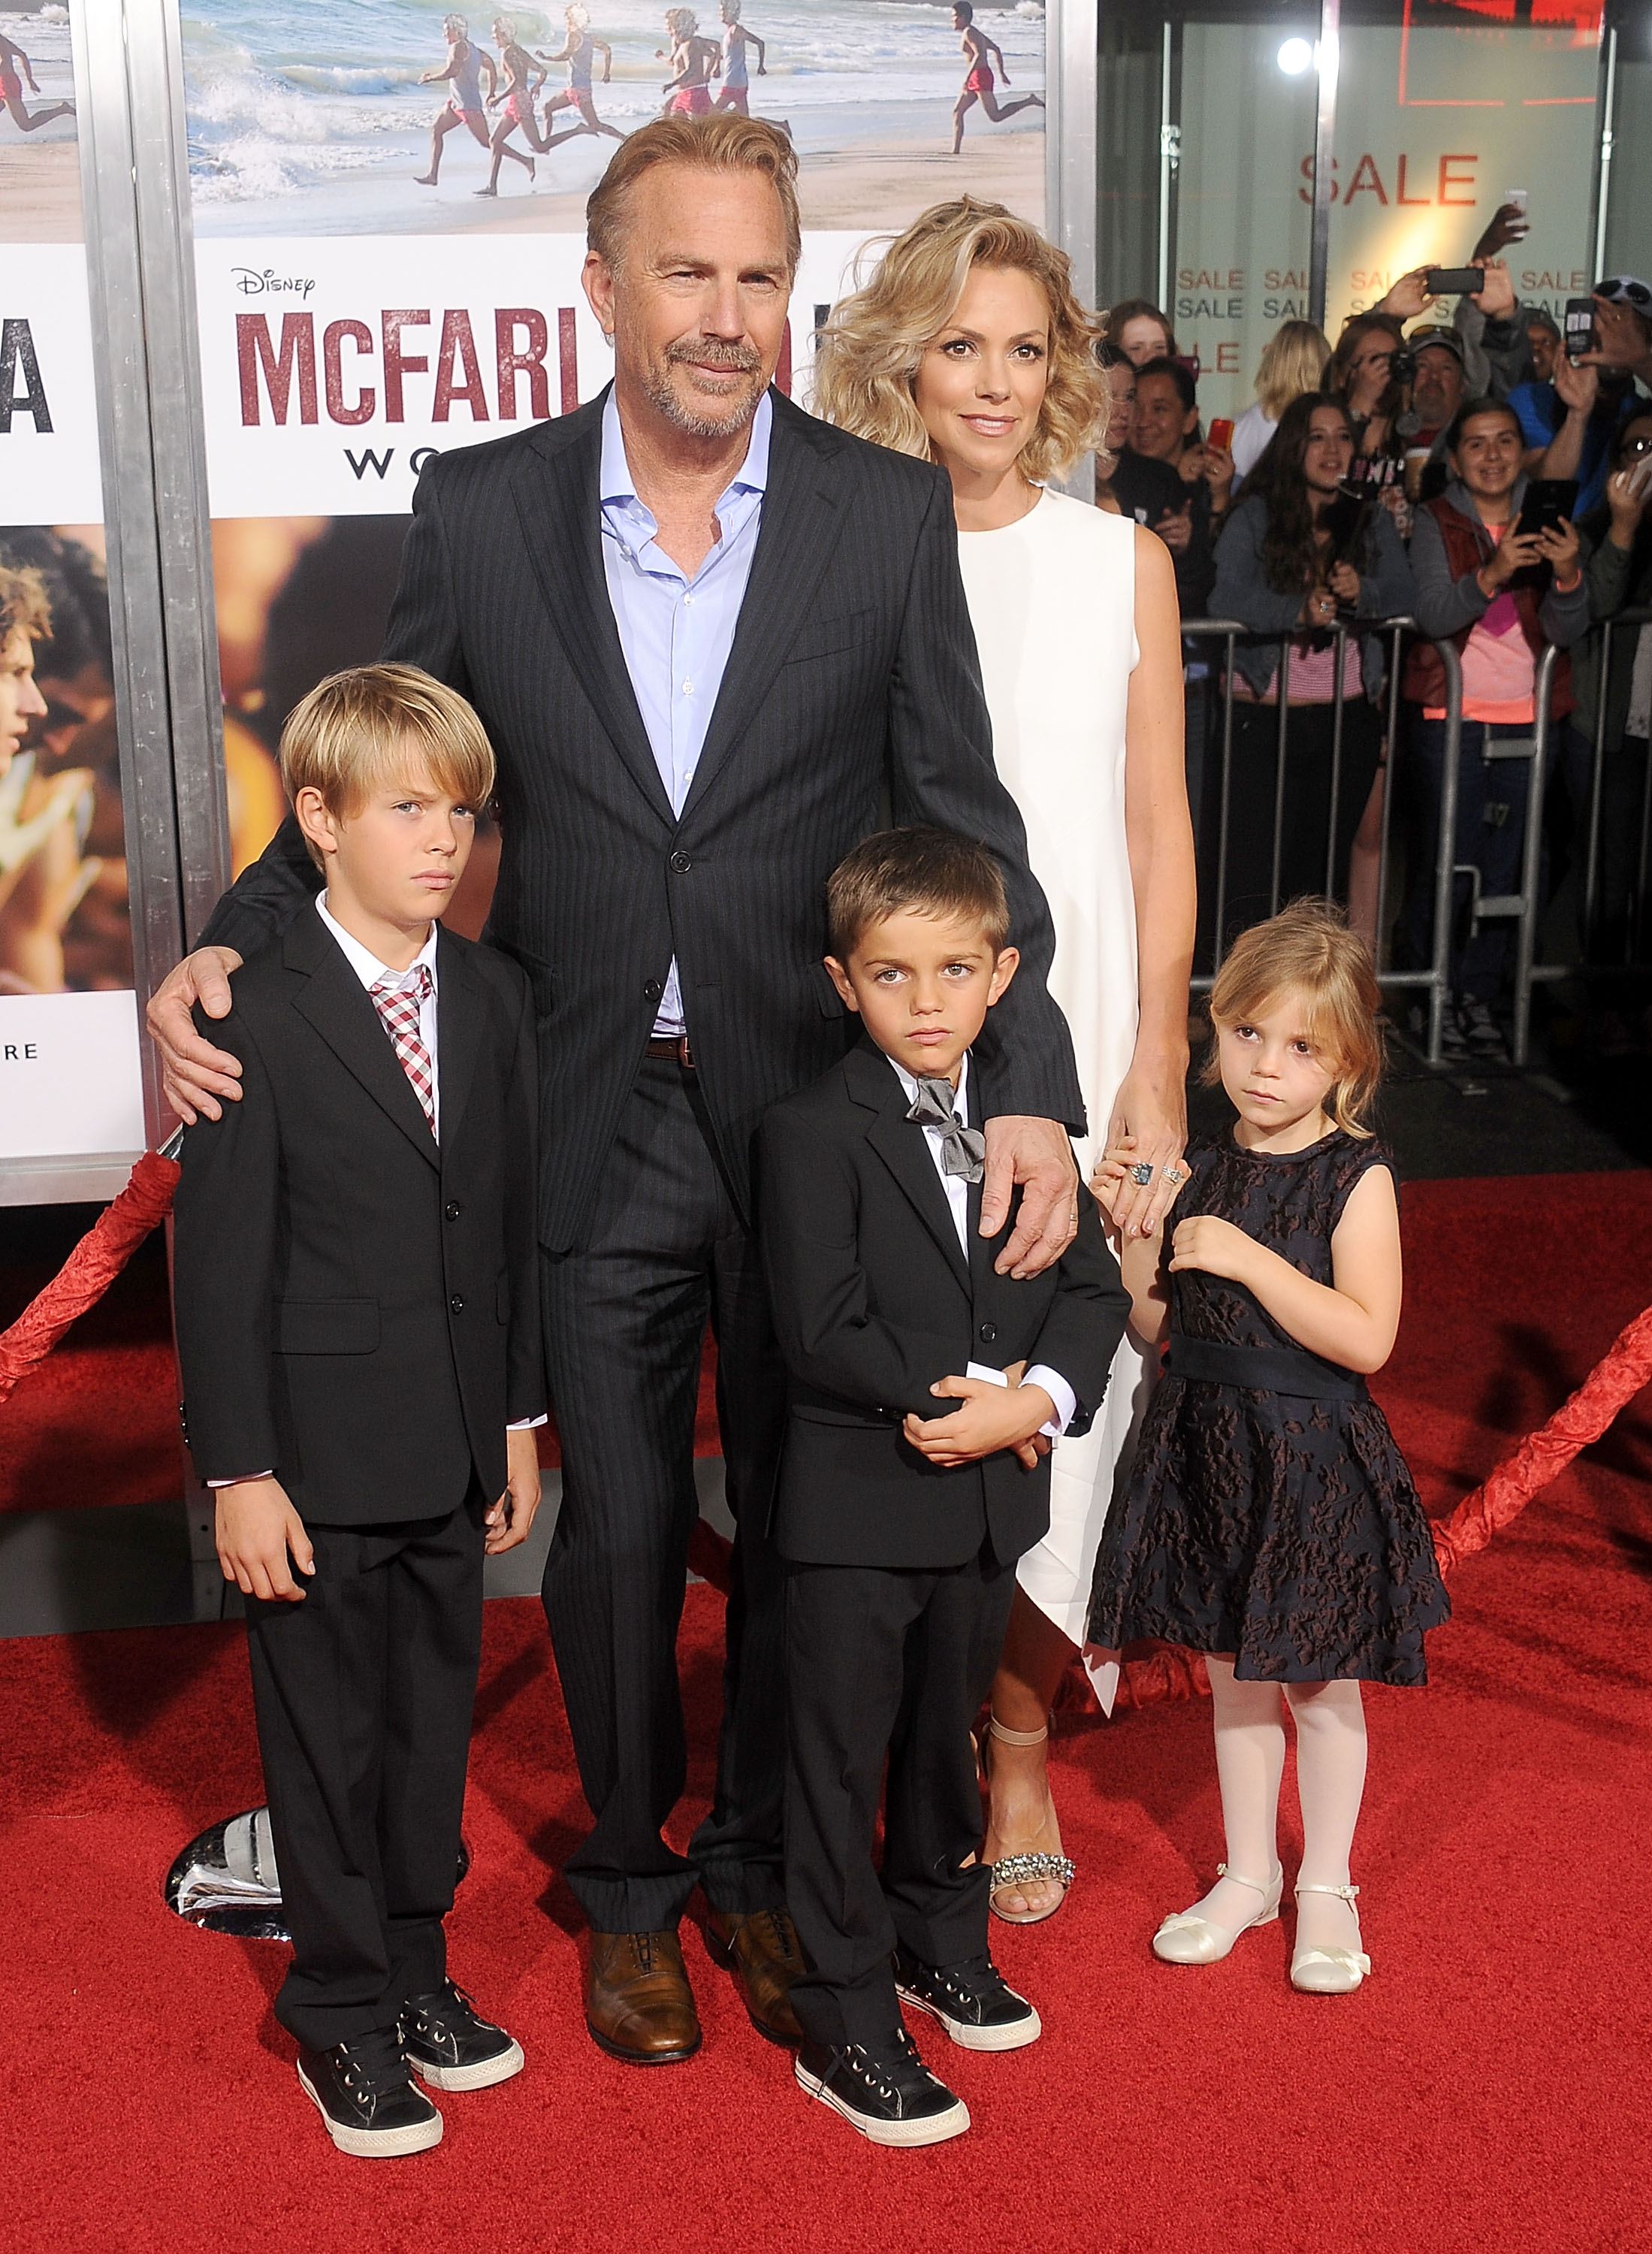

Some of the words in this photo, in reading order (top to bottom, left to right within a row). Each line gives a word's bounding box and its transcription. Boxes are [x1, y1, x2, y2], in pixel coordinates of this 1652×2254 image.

[1297, 154, 1478, 206] SALE
[231, 267, 316, 301] Disney
[1179, 270, 1244, 292] SALE
[1264, 270, 1330, 292] SAL
[1351, 270, 1406, 292] SAL
[1521, 270, 1587, 292] SALE
[1176, 298, 1243, 319] SALE
[1263, 298, 1328, 319] SAL
